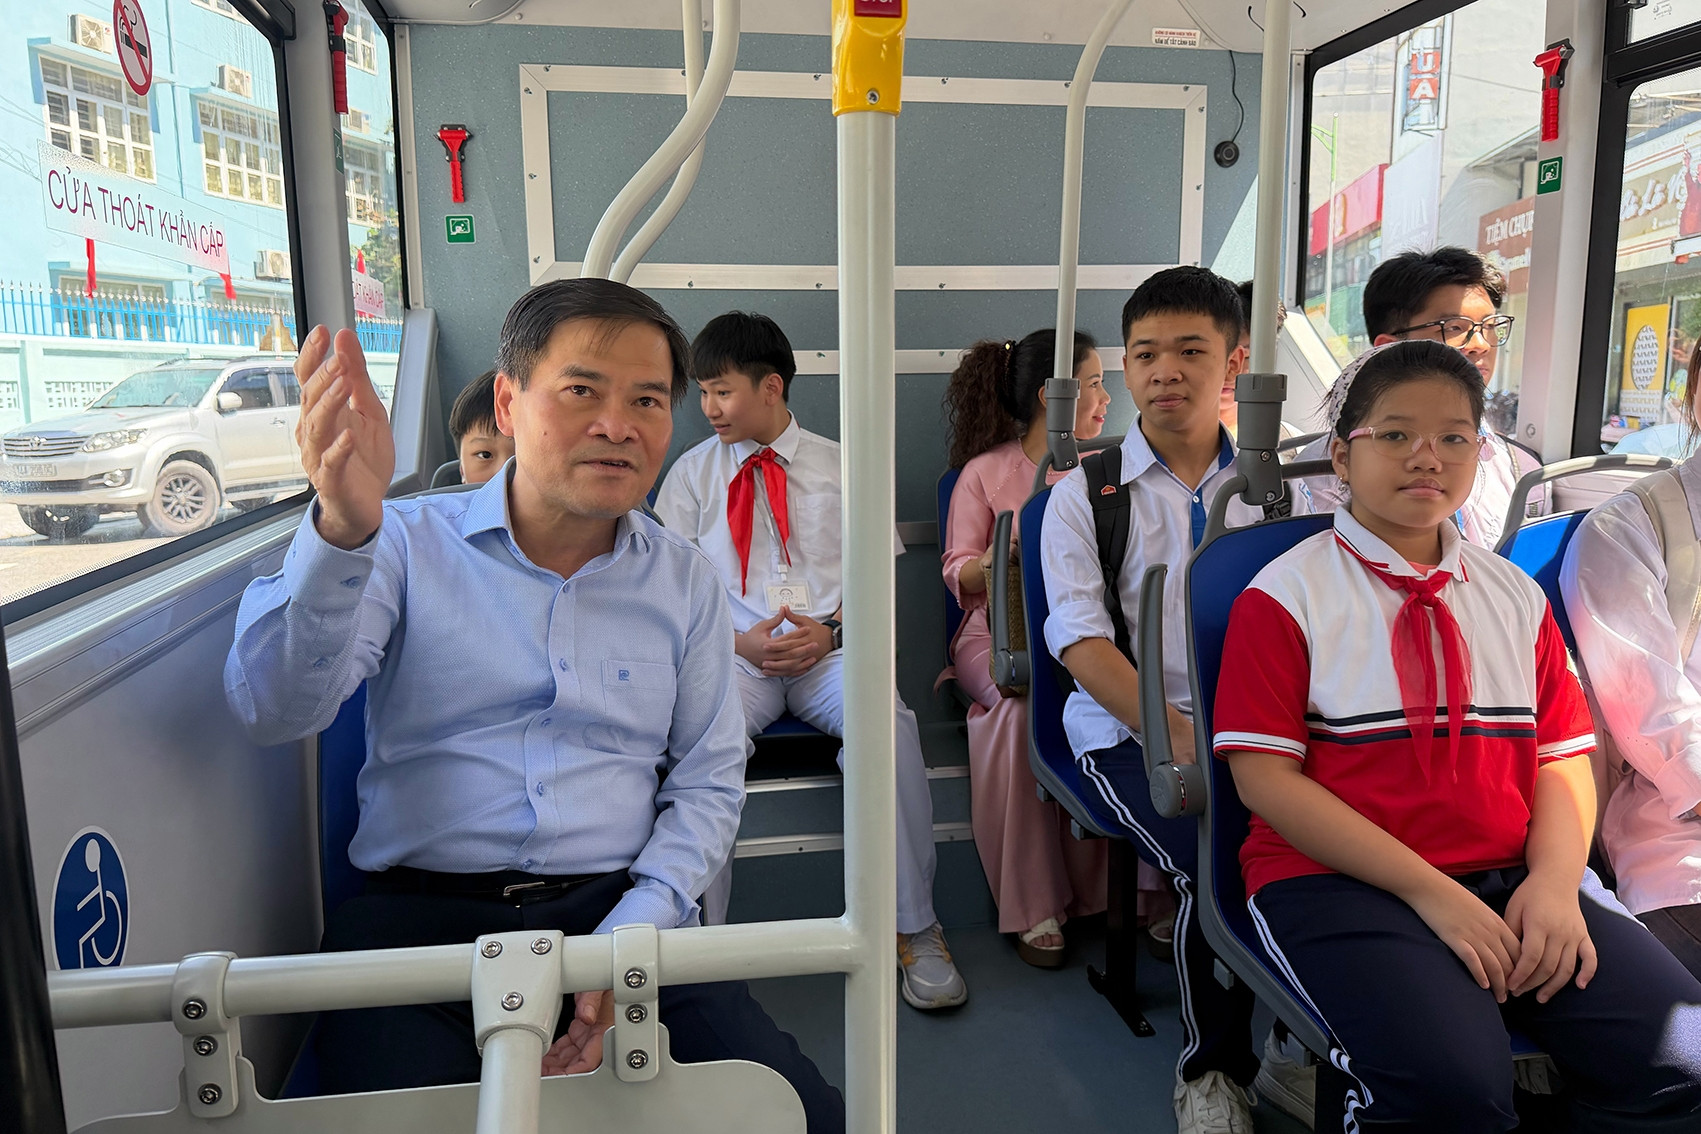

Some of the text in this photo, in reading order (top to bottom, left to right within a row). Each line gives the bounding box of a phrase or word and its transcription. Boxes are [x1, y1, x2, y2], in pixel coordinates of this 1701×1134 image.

[48, 166, 224, 257] CỬA THOÁT KHẨN CẤP
